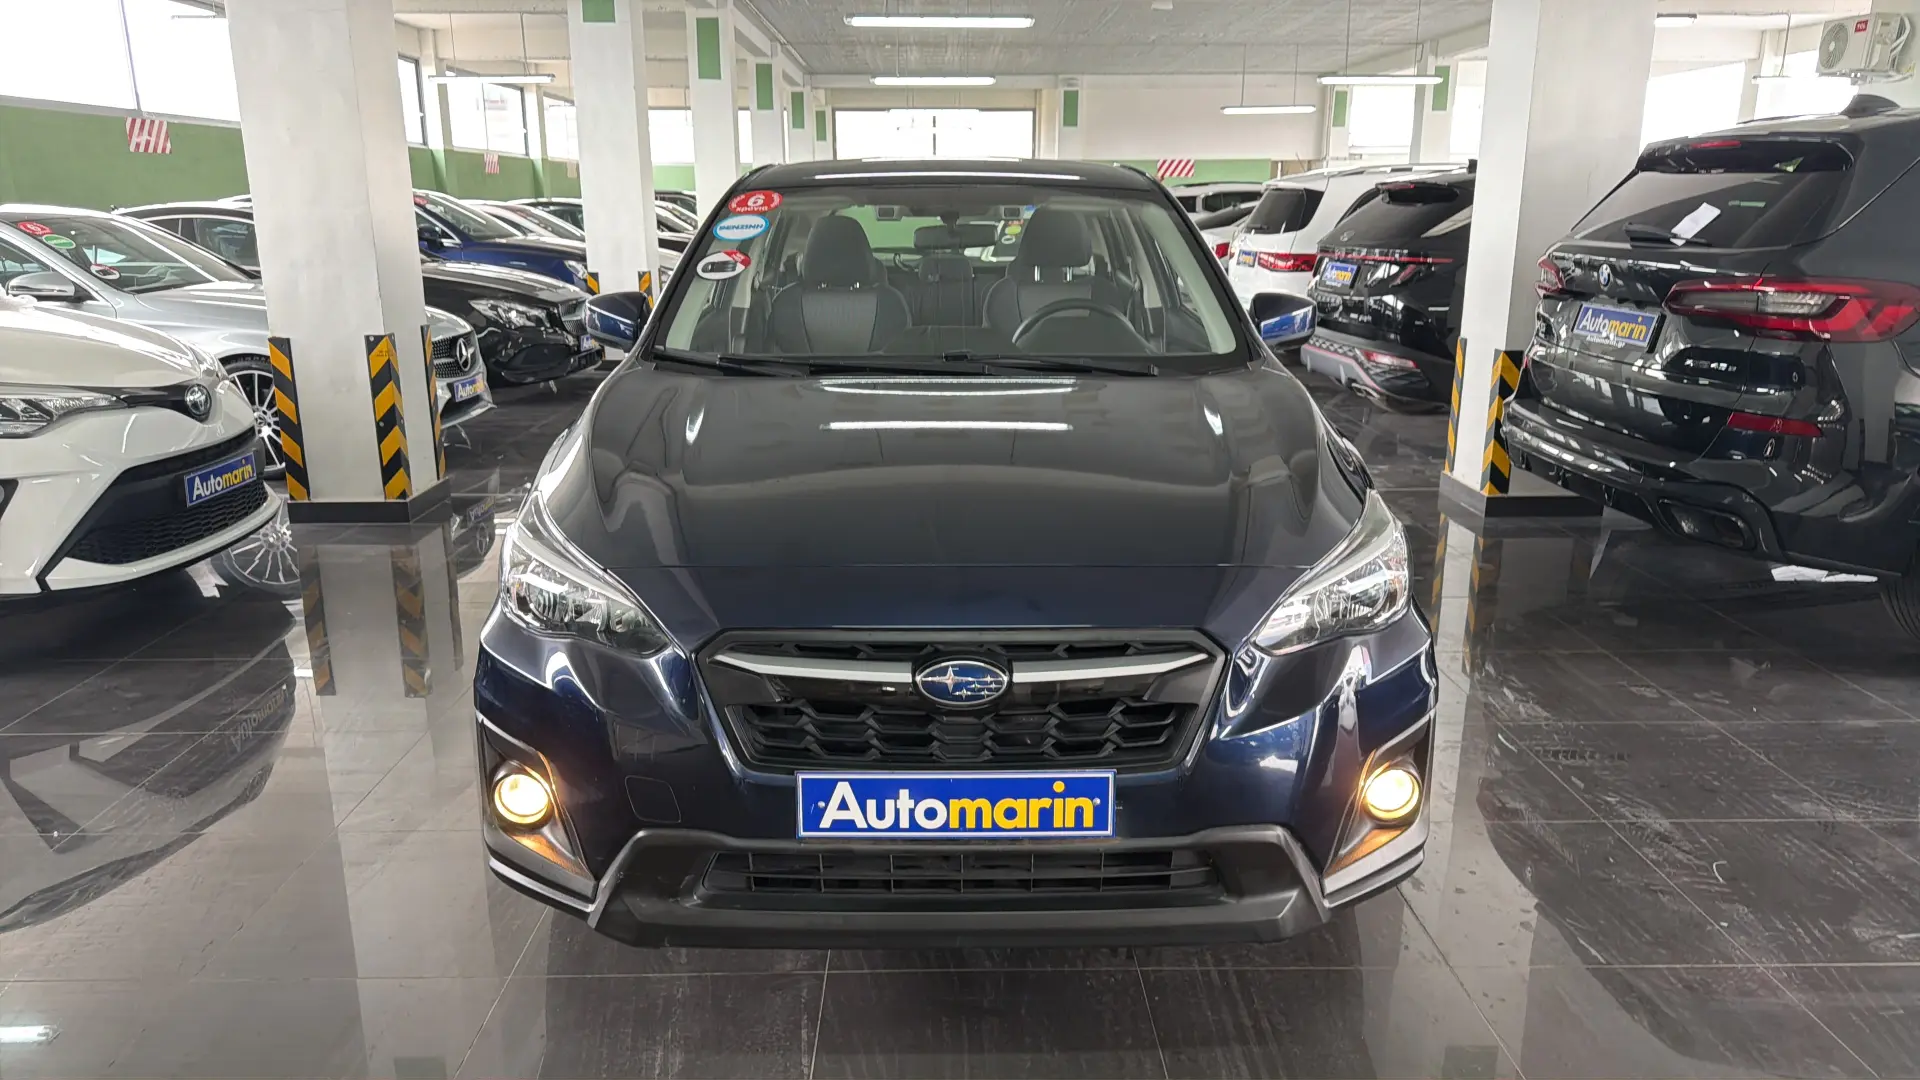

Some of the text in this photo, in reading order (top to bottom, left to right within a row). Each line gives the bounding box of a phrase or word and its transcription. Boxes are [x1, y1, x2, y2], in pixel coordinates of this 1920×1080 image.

[747, 195, 765, 206] 6
[1579, 308, 1647, 341] Automarin
[193, 458, 253, 501] Automarin
[819, 780, 1094, 829] Automarin
